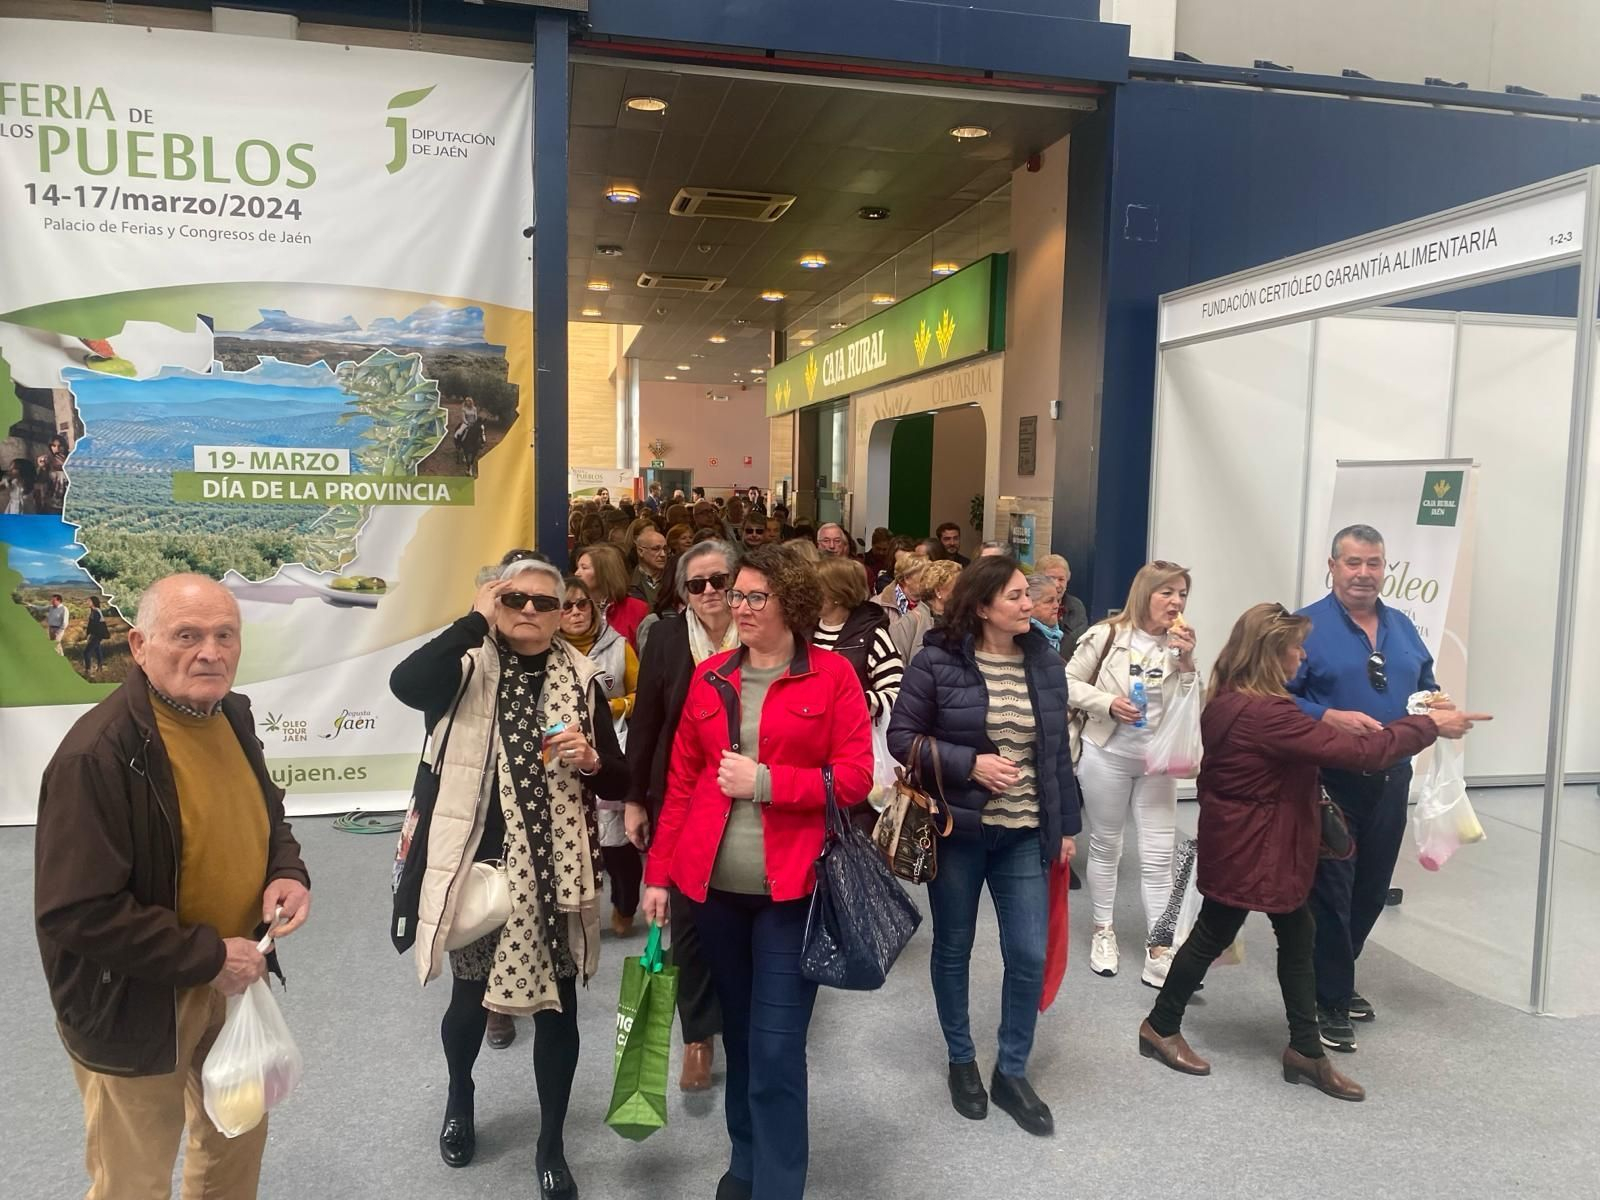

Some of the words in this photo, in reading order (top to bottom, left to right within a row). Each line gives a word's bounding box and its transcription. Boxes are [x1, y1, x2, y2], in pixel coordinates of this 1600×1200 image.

[0, 82, 116, 121] FERIA
[129, 108, 154, 124] DE
[412, 128, 496, 146] DIPUTACIÓN
[412, 143, 432, 155] DE
[433, 145, 468, 158] JAÉN
[0, 123, 34, 139] LOS
[38, 124, 317, 190] PUEBLOS
[24, 182, 303, 221] 14-17/marzo/2024
[44, 216, 96, 233] Palacio
[99, 219, 118, 234] de
[121, 221, 164, 236] Ferias
[168, 226, 176, 240] y
[180, 224, 255, 244] Congresos
[259, 228, 277, 243] de
[280, 230, 312, 245] Jaén
[1549, 231, 1573, 246] 1-2-3
[1202, 288, 1257, 319] FUNDACIÓN
[1259, 273, 1322, 306] CERTIÓLEO
[1325, 253, 1391, 289] GARANTÍA
[1394, 226, 1498, 272] ALIMENTARIA
[822, 347, 846, 387] CAJA
[847, 329, 887, 379] RURAL
[931, 366, 992, 404] OLIVARUM
[250, 452, 340, 472] MARZO
[203, 476, 245, 499] DÍA
[252, 480, 283, 499] DE
[289, 481, 318, 500] LA
[325, 482, 451, 502] PROVINCIA
[282, 720, 307, 728] OLEO
[272, 764, 367, 787] ujaen.es
